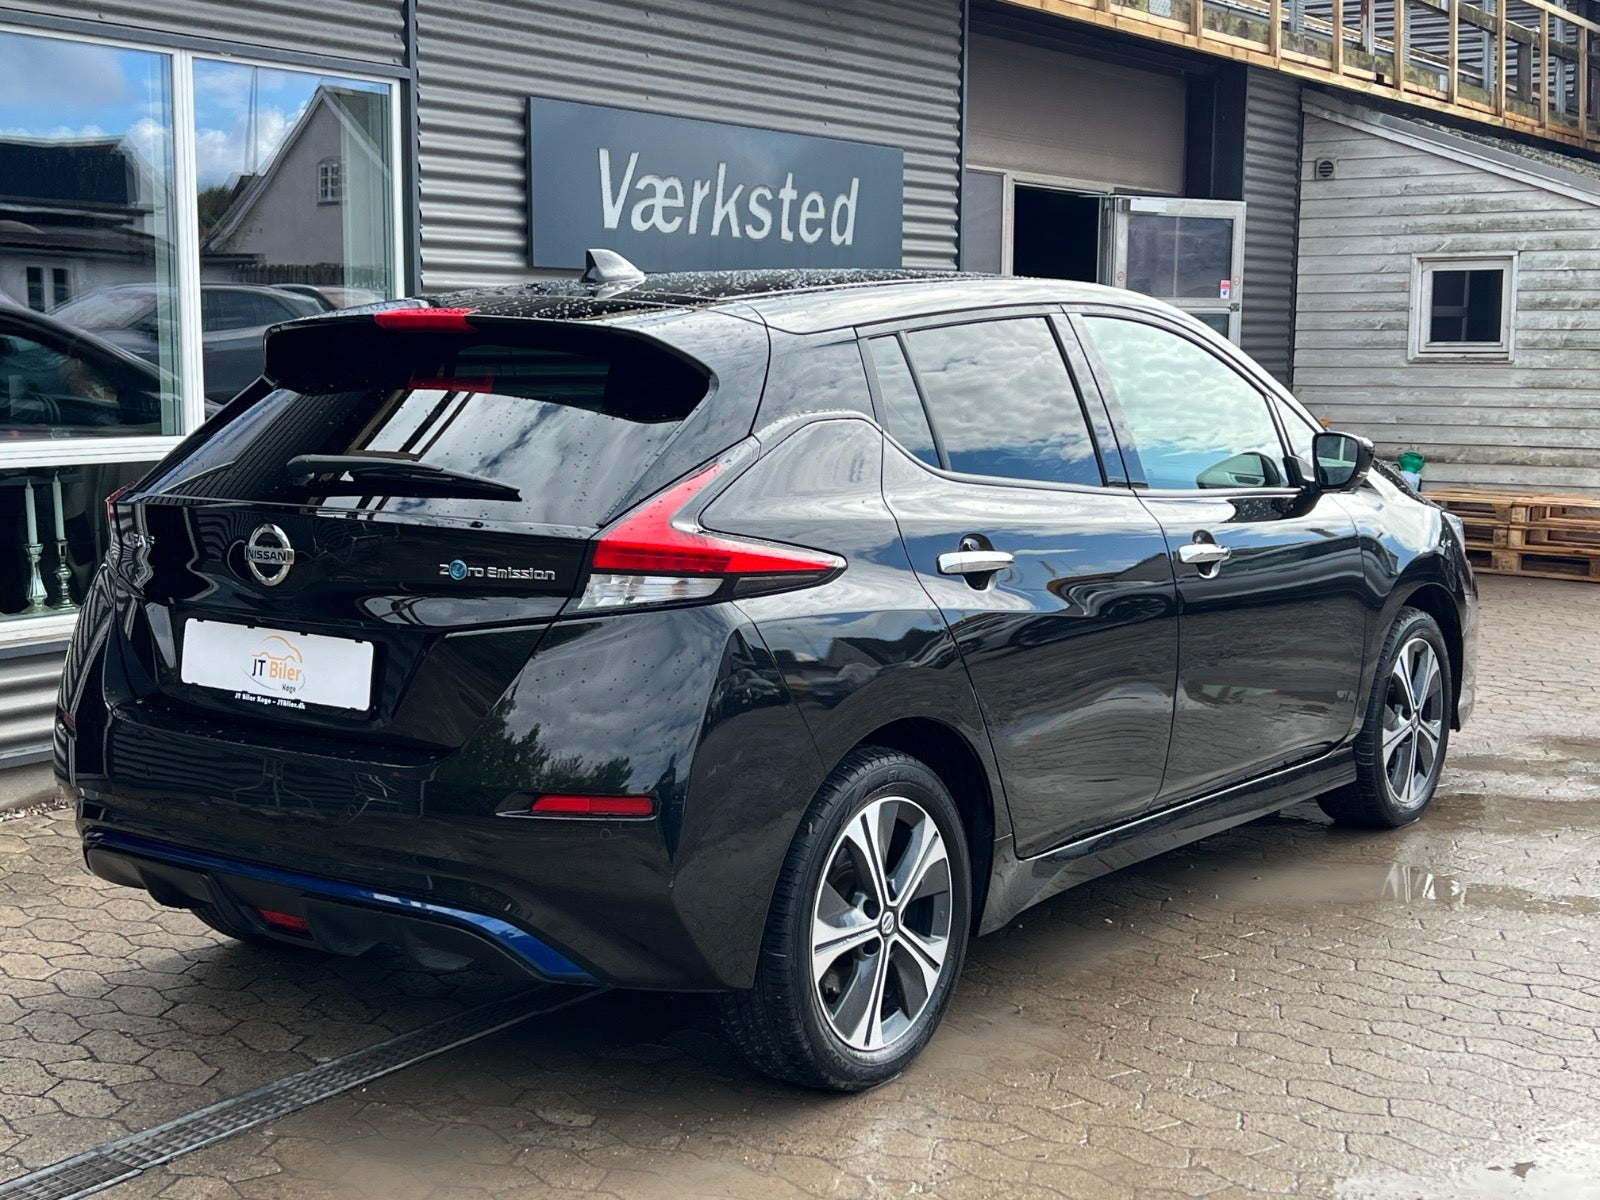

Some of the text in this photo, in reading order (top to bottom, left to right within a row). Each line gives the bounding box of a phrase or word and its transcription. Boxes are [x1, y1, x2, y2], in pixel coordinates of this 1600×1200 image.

[598, 148, 860, 246] Værksted
[246, 547, 287, 562] NISSAN
[486, 566, 556, 580] Emission
[252, 659, 301, 681] JT Biler
[242, 693, 256, 701] Biler
